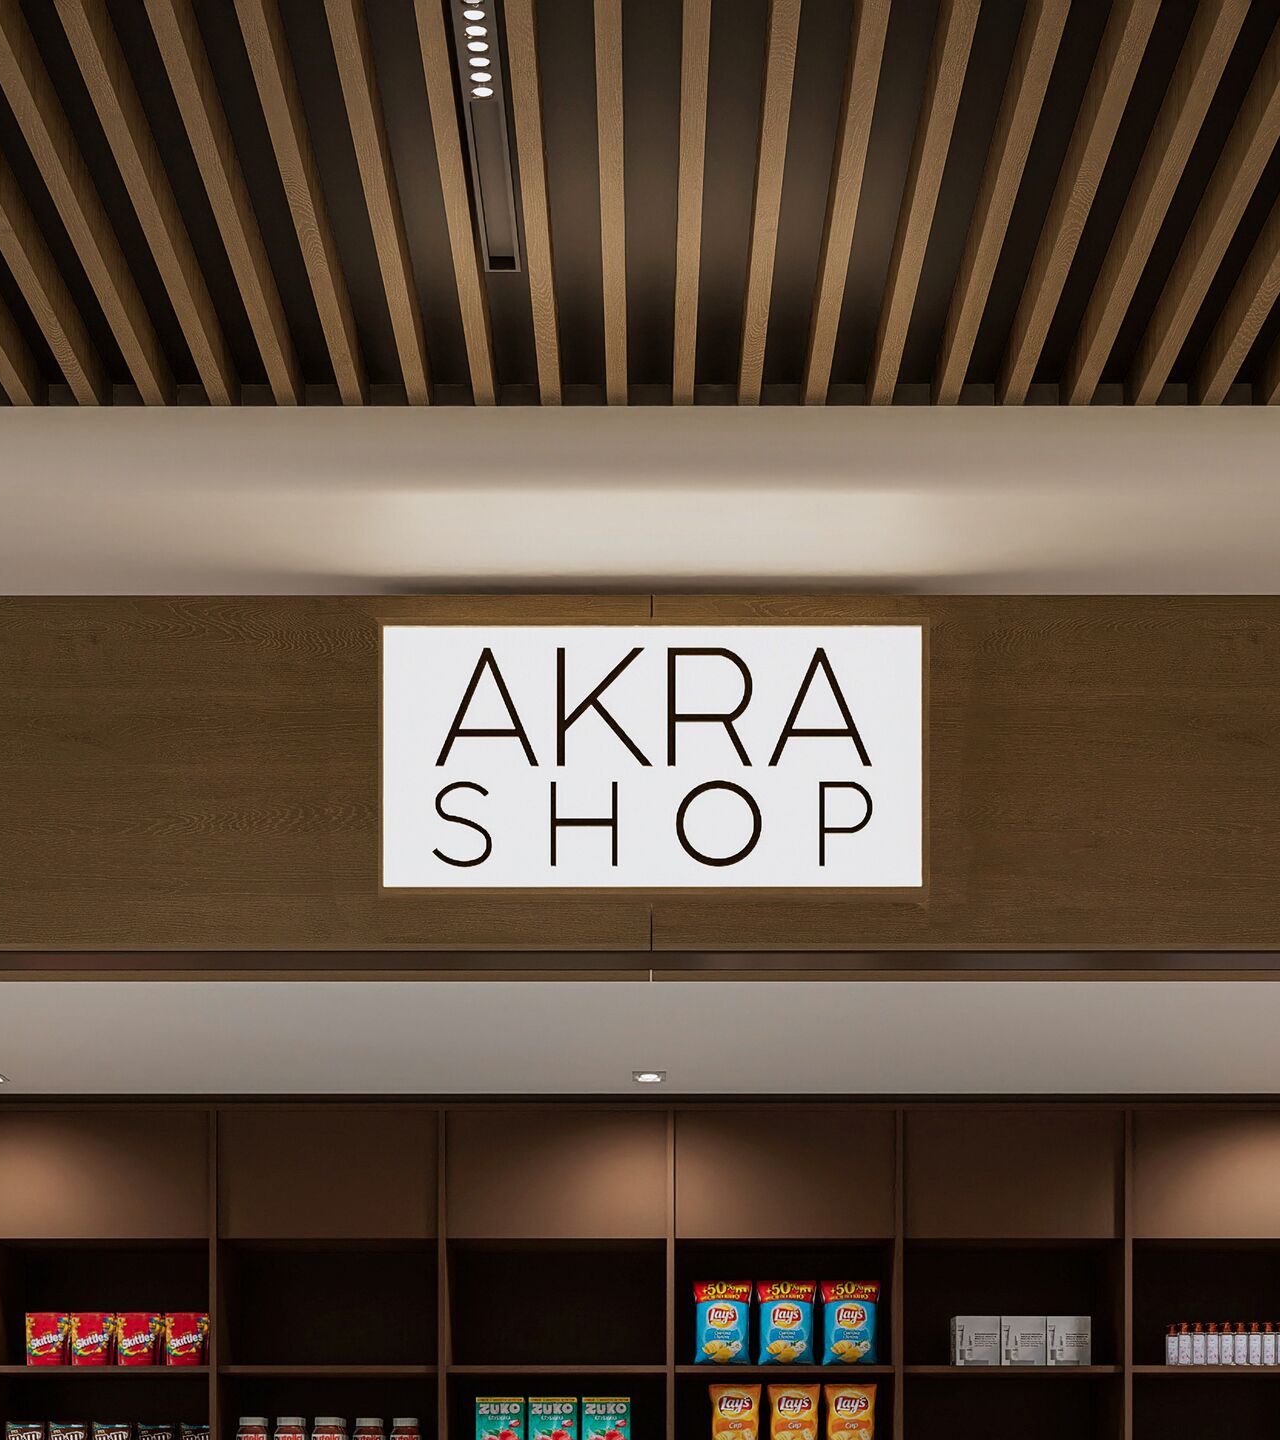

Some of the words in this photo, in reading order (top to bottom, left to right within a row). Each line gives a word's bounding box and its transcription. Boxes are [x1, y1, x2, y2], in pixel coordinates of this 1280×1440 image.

[435, 647, 873, 768] AKRA
[432, 780, 874, 868] SHOP
[709, 1307, 735, 1325] Lay's
[774, 1307, 800, 1325] Lay's
[838, 1307, 864, 1325] Lay's
[30, 1333, 64, 1350] Skittles
[75, 1333, 109, 1350] Skittles
[121, 1333, 156, 1350] Skittles
[169, 1333, 204, 1350] Skittles
[478, 1403, 521, 1415] ZUKO
[531, 1403, 574, 1415] ZUKO
[584, 1403, 627, 1415] ZUKO
[719, 1395, 751, 1414] Lay's
[779, 1395, 810, 1414] Lay's
[835, 1395, 867, 1414] Lay's
